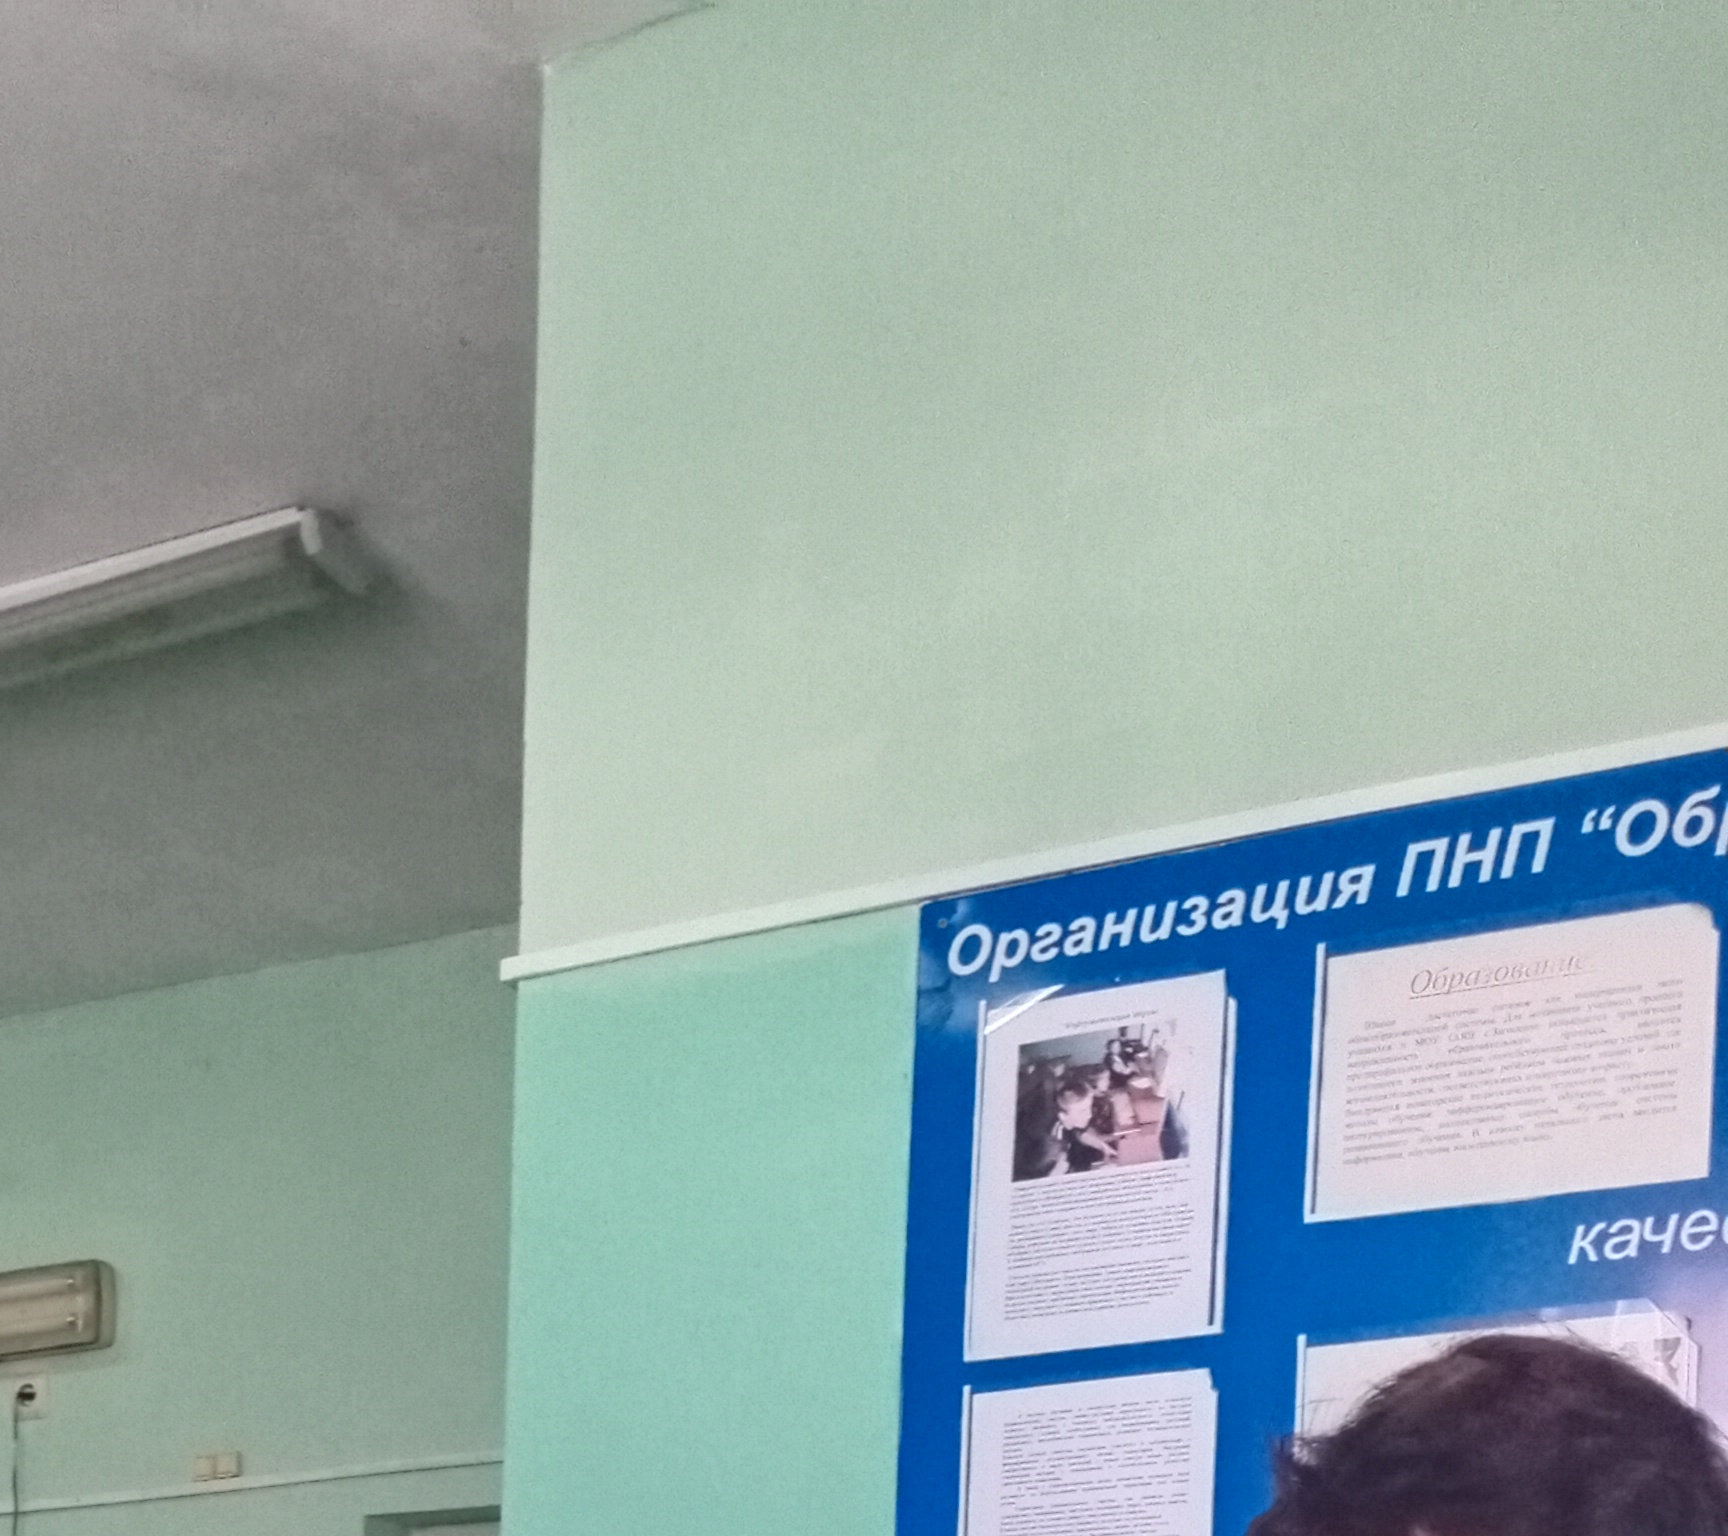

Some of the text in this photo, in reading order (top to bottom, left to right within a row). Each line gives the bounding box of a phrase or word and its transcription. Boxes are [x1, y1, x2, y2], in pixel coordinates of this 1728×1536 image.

[946, 862, 1375, 982] Организация
[1395, 816, 1556, 898] ПНП
[1567, 1208, 1728, 1265] каче
